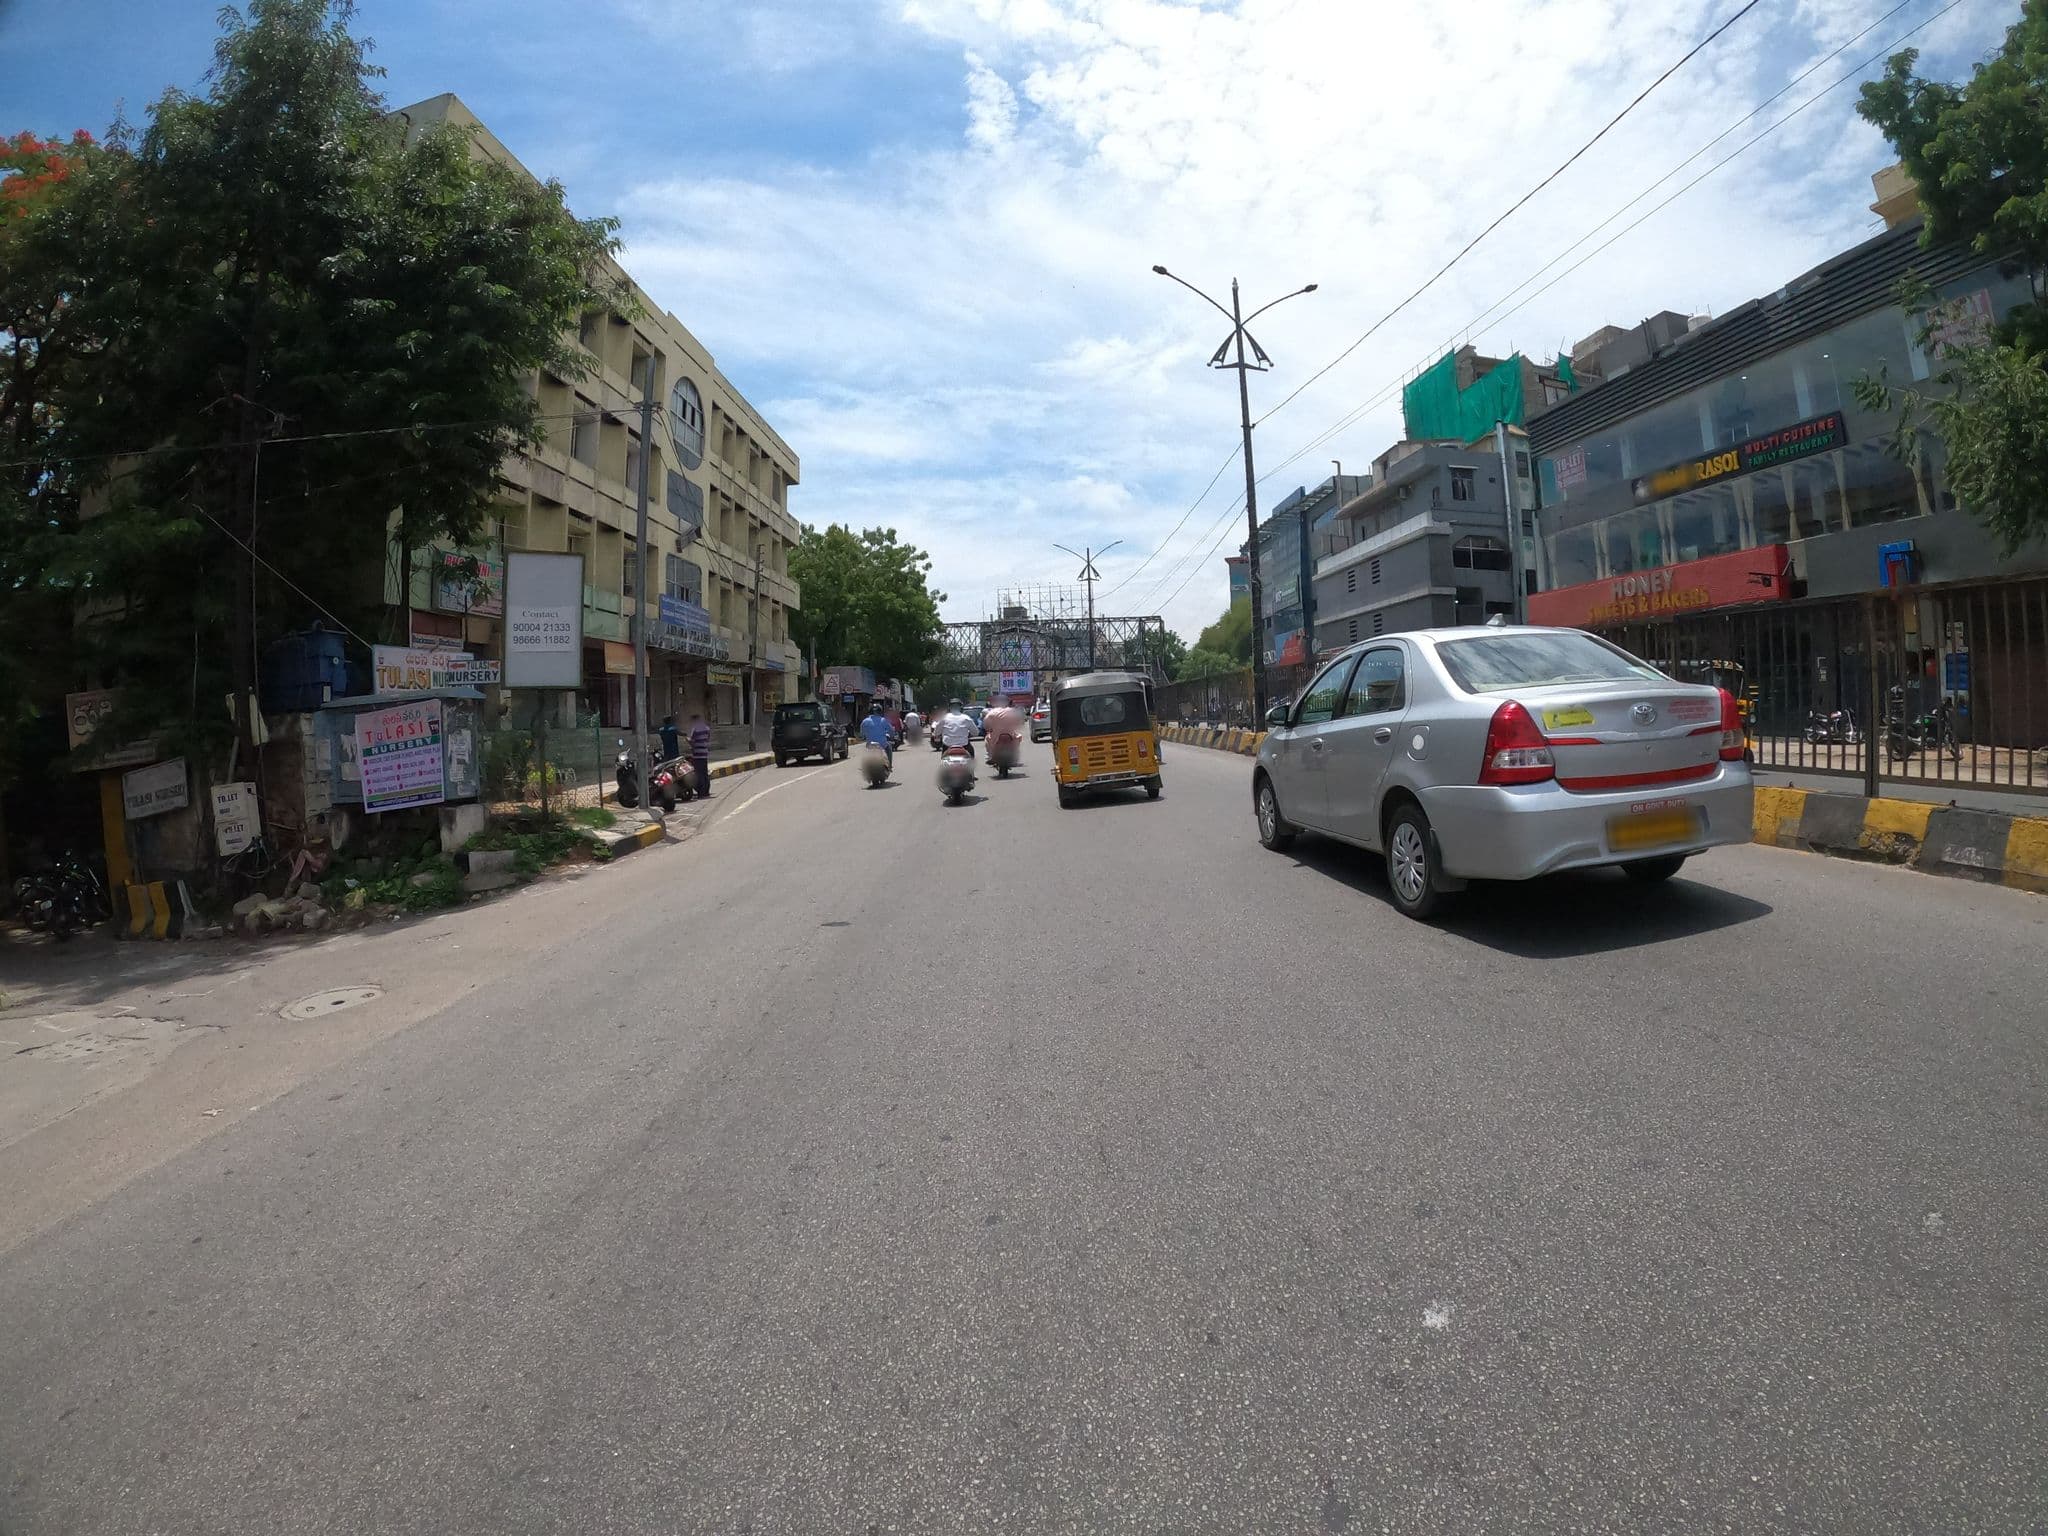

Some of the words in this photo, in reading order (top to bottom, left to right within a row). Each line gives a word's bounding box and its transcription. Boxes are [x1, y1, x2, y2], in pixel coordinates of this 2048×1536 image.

[1744, 434, 1780, 455] MULTI
[1783, 417, 1835, 443] CUISINE
[1749, 451, 1777, 467] FAMILY
[1778, 433, 1835, 459] RESTAURANT
[1695, 450, 1740, 480] RASOI
[1611, 568, 1674, 601] HONEY
[1639, 594, 1649, 613] &
[1652, 586, 1710, 611] BAKERS
[522, 607, 560, 619] Contact
[513, 623, 541, 633] 90004
[543, 623, 571, 633] 21333
[513, 635, 541, 645] 98666
[544, 635, 571, 645] 11882
[467, 661, 490, 670] TULASI
[376, 665, 432, 690] TULASI
[449, 670, 499, 682] NURSERY
[371, 736, 432, 755] NURSERY
[1631, 803, 1644, 813] ON
